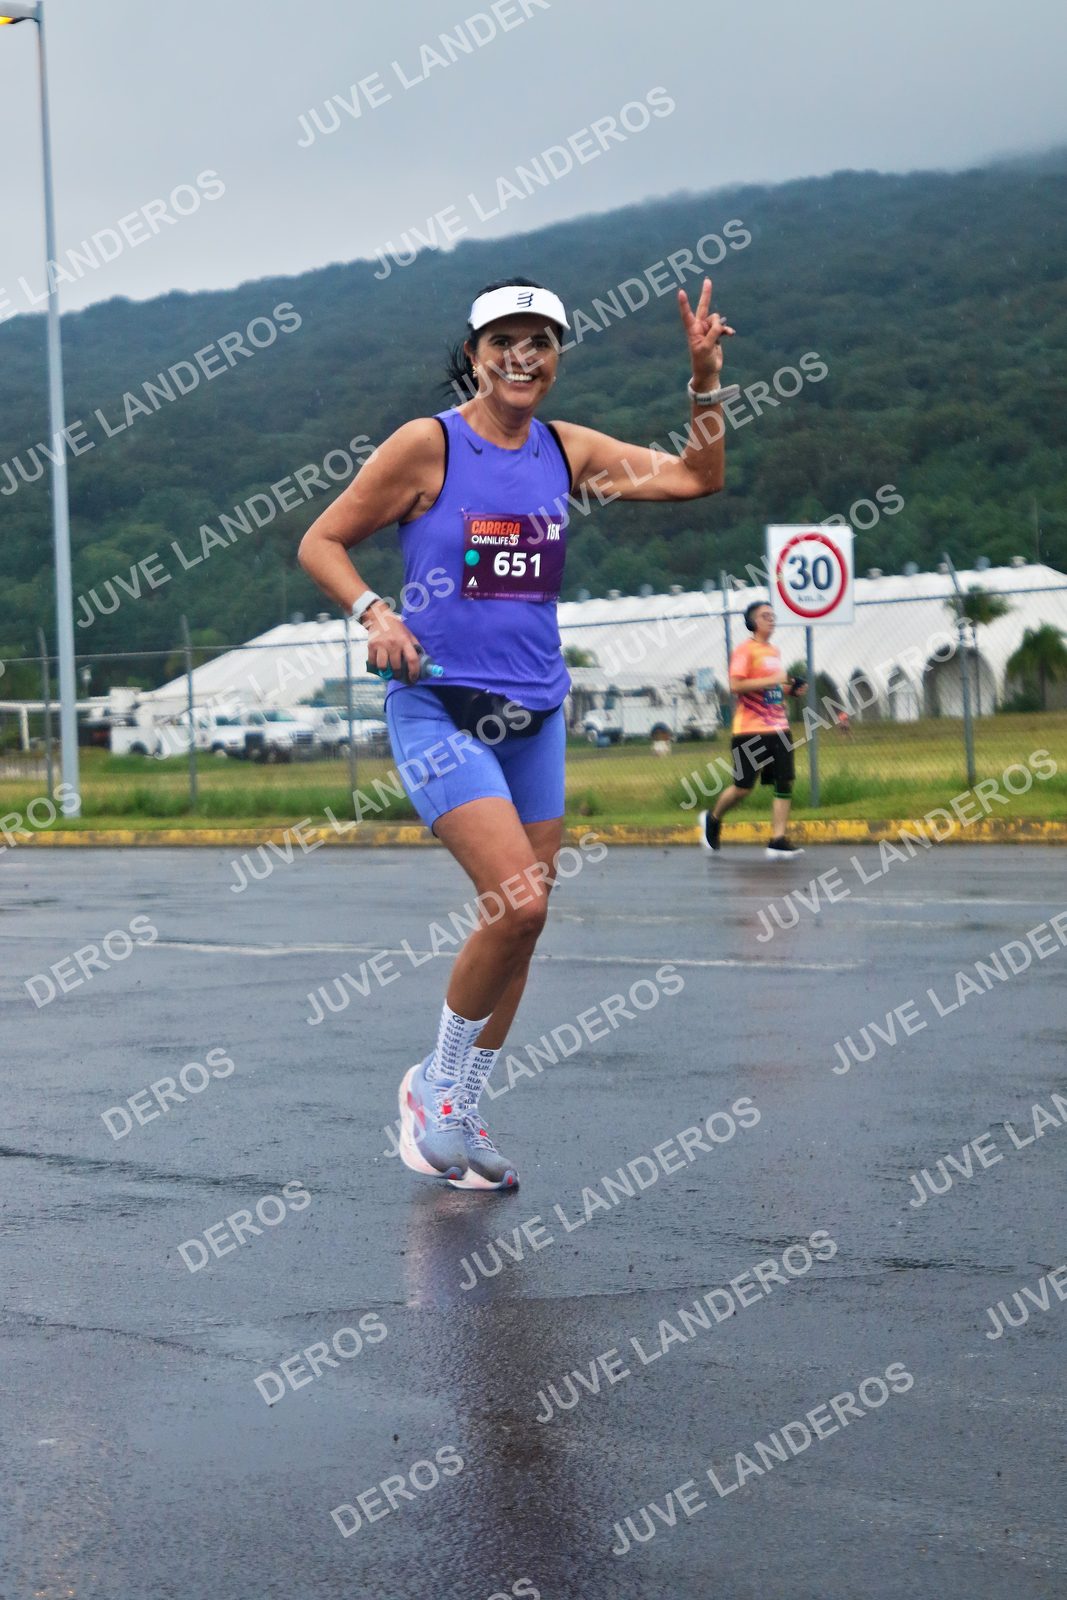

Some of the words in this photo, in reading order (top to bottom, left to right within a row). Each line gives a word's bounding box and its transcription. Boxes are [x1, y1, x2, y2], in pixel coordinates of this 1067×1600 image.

[472, 520, 520, 535] CARRERA
[471, 535, 509, 545] OMNILIFE
[494, 551, 540, 577] 651
[788, 554, 834, 591] 30
